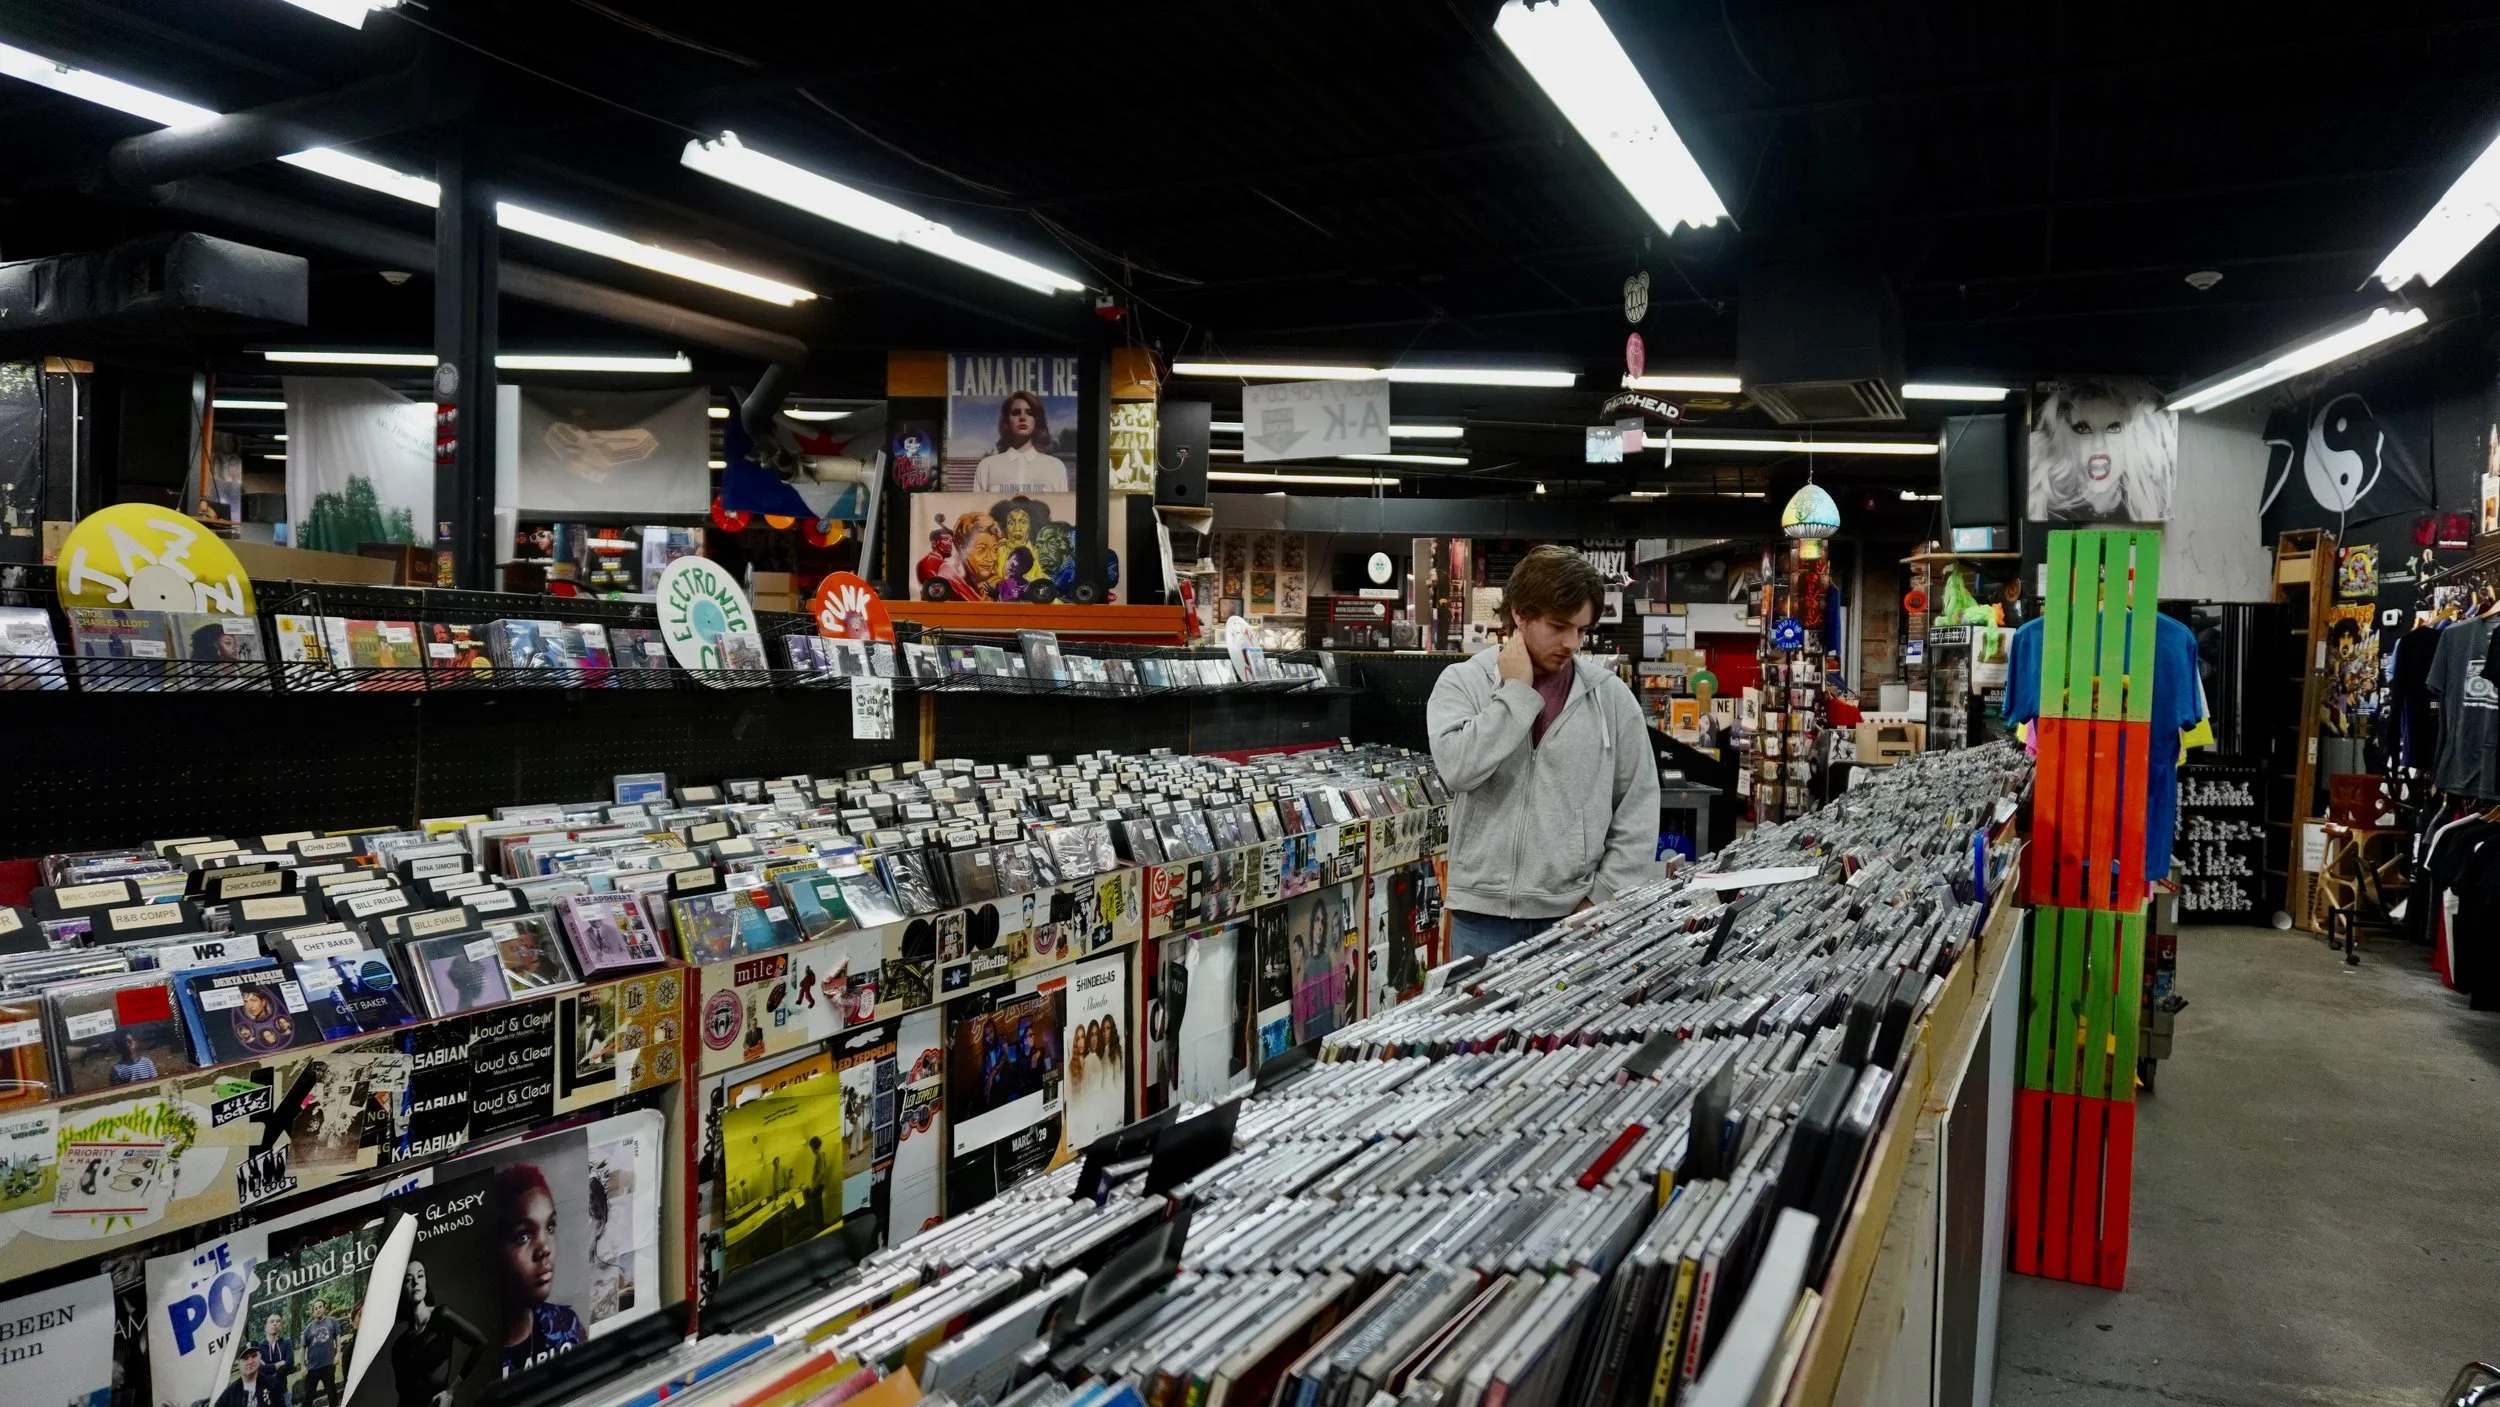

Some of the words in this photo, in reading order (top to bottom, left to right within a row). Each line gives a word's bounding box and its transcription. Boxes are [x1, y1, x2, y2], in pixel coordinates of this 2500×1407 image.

[949, 357, 1012, 397] LANA
[1012, 357, 1050, 396] DEL
[1603, 394, 1680, 419] RADIOHEAD
[68, 519, 246, 615] JAZZ
[672, 566, 748, 643] ELECTRONIC
[823, 583, 873, 632] PUNK
[76, 618, 120, 628] CHARLES
[121, 620, 150, 628] LLOYD
[303, 844, 324, 852] JOHN
[325, 842, 346, 850] ZORN
[952, 834, 974, 843] ACHILLES
[416, 864, 434, 872] NINA
[435, 861, 460, 870] SIMONE
[88, 888, 124, 899] GOSPEL
[225, 882, 249, 892] CHICK
[251, 879, 278, 889] COREA
[355, 901, 372, 910] BILL
[372, 894, 402, 907] FRISELL
[574, 896, 592, 904] NAT
[593, 893, 632, 902] ADDERLEY
[116, 912, 138, 924] R&B
[139, 909, 176, 921] COMPS
[414, 920, 433, 930] BILL
[434, 915, 461, 926] EVANS
[192, 943, 225, 960] WAR
[303, 941, 324, 952] CHET
[327, 937, 355, 948] BAKER
[736, 961, 773, 983] mile
[971, 954, 1009, 976] Fratellis
[1076, 970, 1116, 992] SHINDELLAS
[335, 1003, 360, 1015] CHET
[360, 997, 388, 1011] BAKER
[627, 990, 643, 1009] Lit
[475, 1020, 506, 1039] Loud
[508, 1016, 519, 1029] &
[522, 1010, 554, 1028] Clear
[412, 1044, 468, 1070] SABIAN
[474, 1055, 505, 1074] Loud
[508, 1051, 519, 1065] &
[522, 1044, 553, 1061] Clear
[852, 1041, 896, 1068] ZEPPELIN
[493, 1068, 508, 1076] Moods
[473, 1094, 504, 1114] Loud
[506, 1090, 517, 1103] &
[520, 1081, 552, 1100] Clear
[905, 1095, 916, 1107] LED
[916, 1087, 939, 1104] ZEPPELIN
[215, 1106, 248, 1125] ROCK
[367, 1111, 386, 1121] NG
[491, 1107, 506, 1116] Moods
[1011, 1126, 1040, 1152] MARC
[1038, 1126, 1047, 1142] 29
[67, 1148, 116, 1158] PRIORITY
[425, 1190, 485, 1221] GLASPY
[417, 1214, 474, 1242] DIAMOND
[265, 1256, 337, 1298] found
[341, 1243, 378, 1278] glo
[167, 1255, 258, 1357] PO
[0, 1304, 75, 1343] BEEN
[1, 1341, 44, 1366] inn
